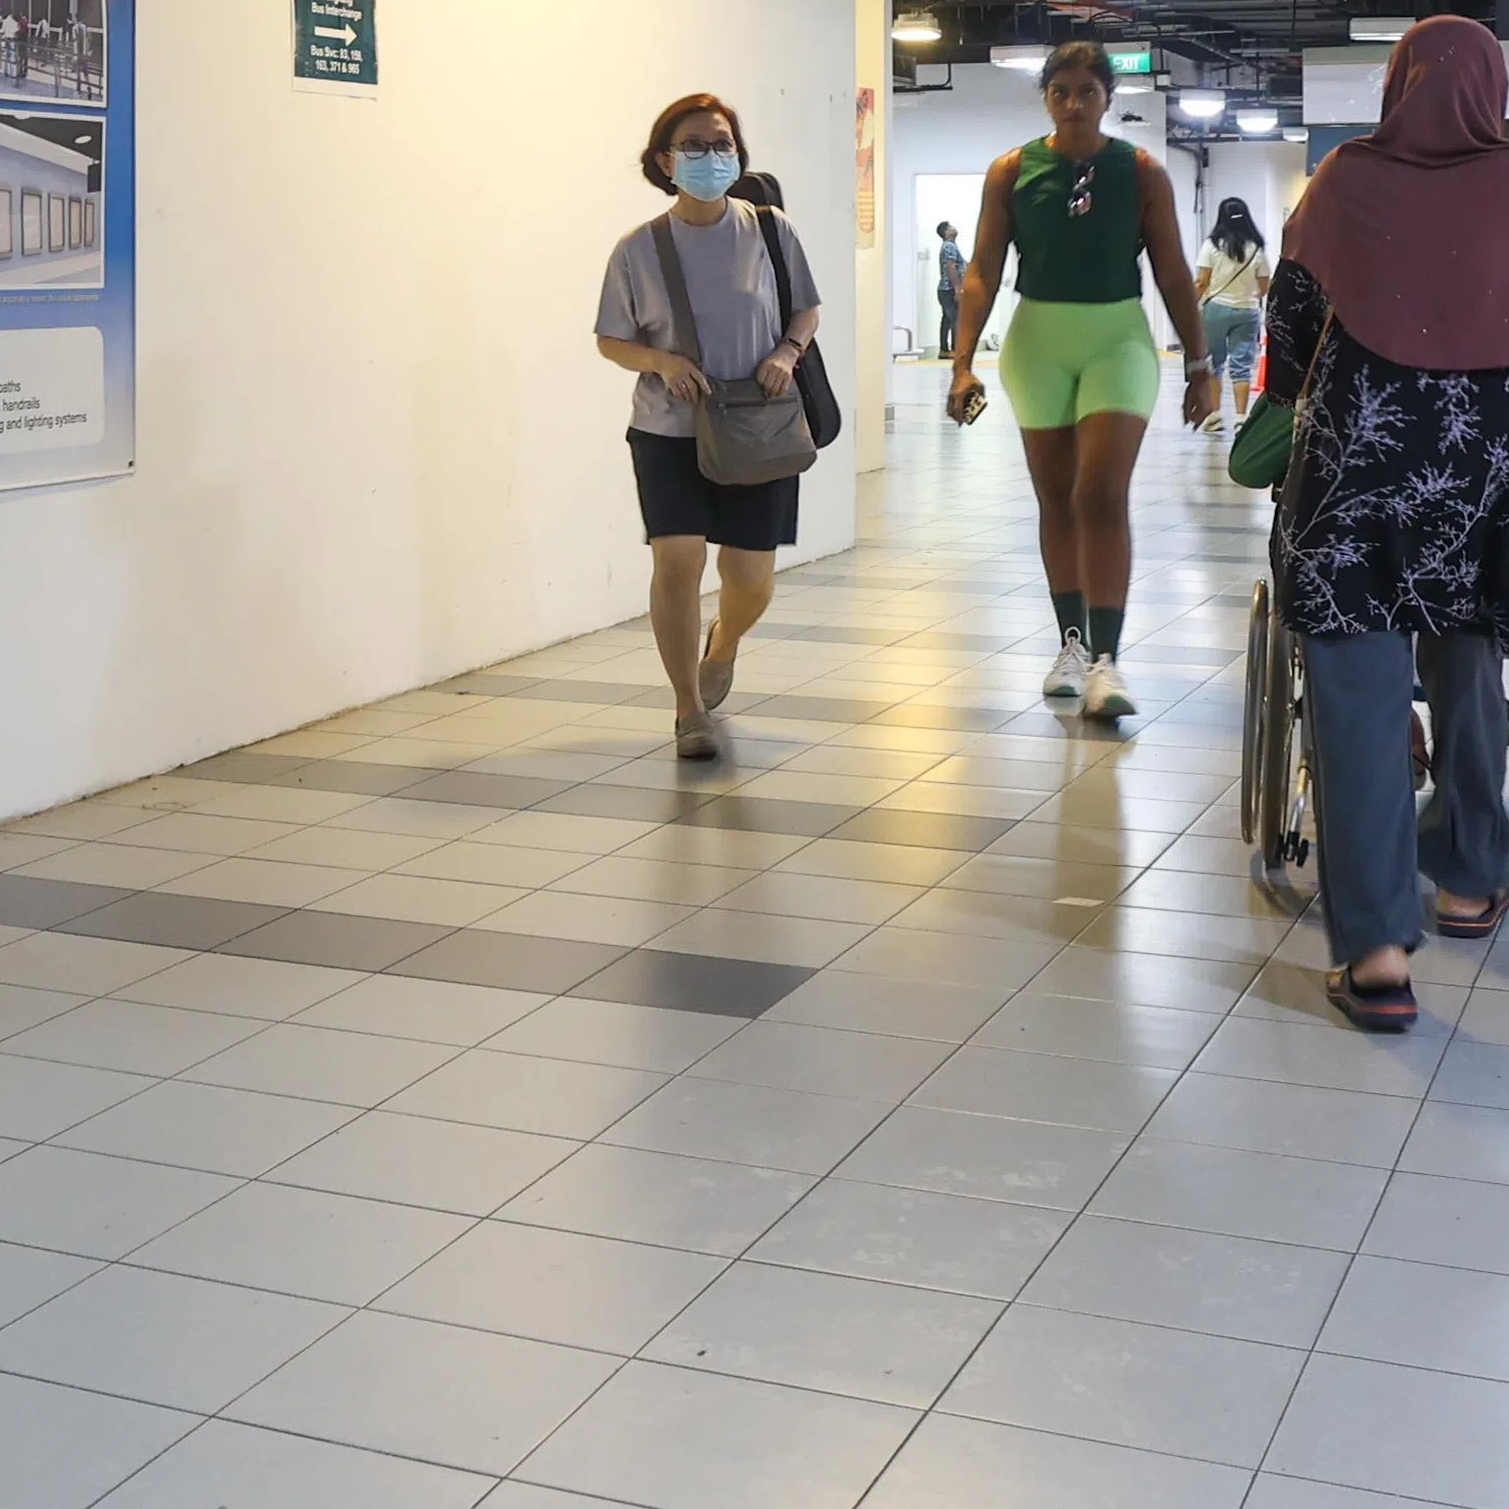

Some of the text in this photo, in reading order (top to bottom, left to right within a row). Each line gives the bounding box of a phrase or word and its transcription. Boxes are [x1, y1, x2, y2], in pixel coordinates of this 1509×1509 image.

[311, 1, 362, 21] Bus Interchange
[2, 397, 41, 412] handrails
[6, 417, 22, 430] and
[23, 414, 53, 431] lighting
[55, 411, 88, 428] systems
